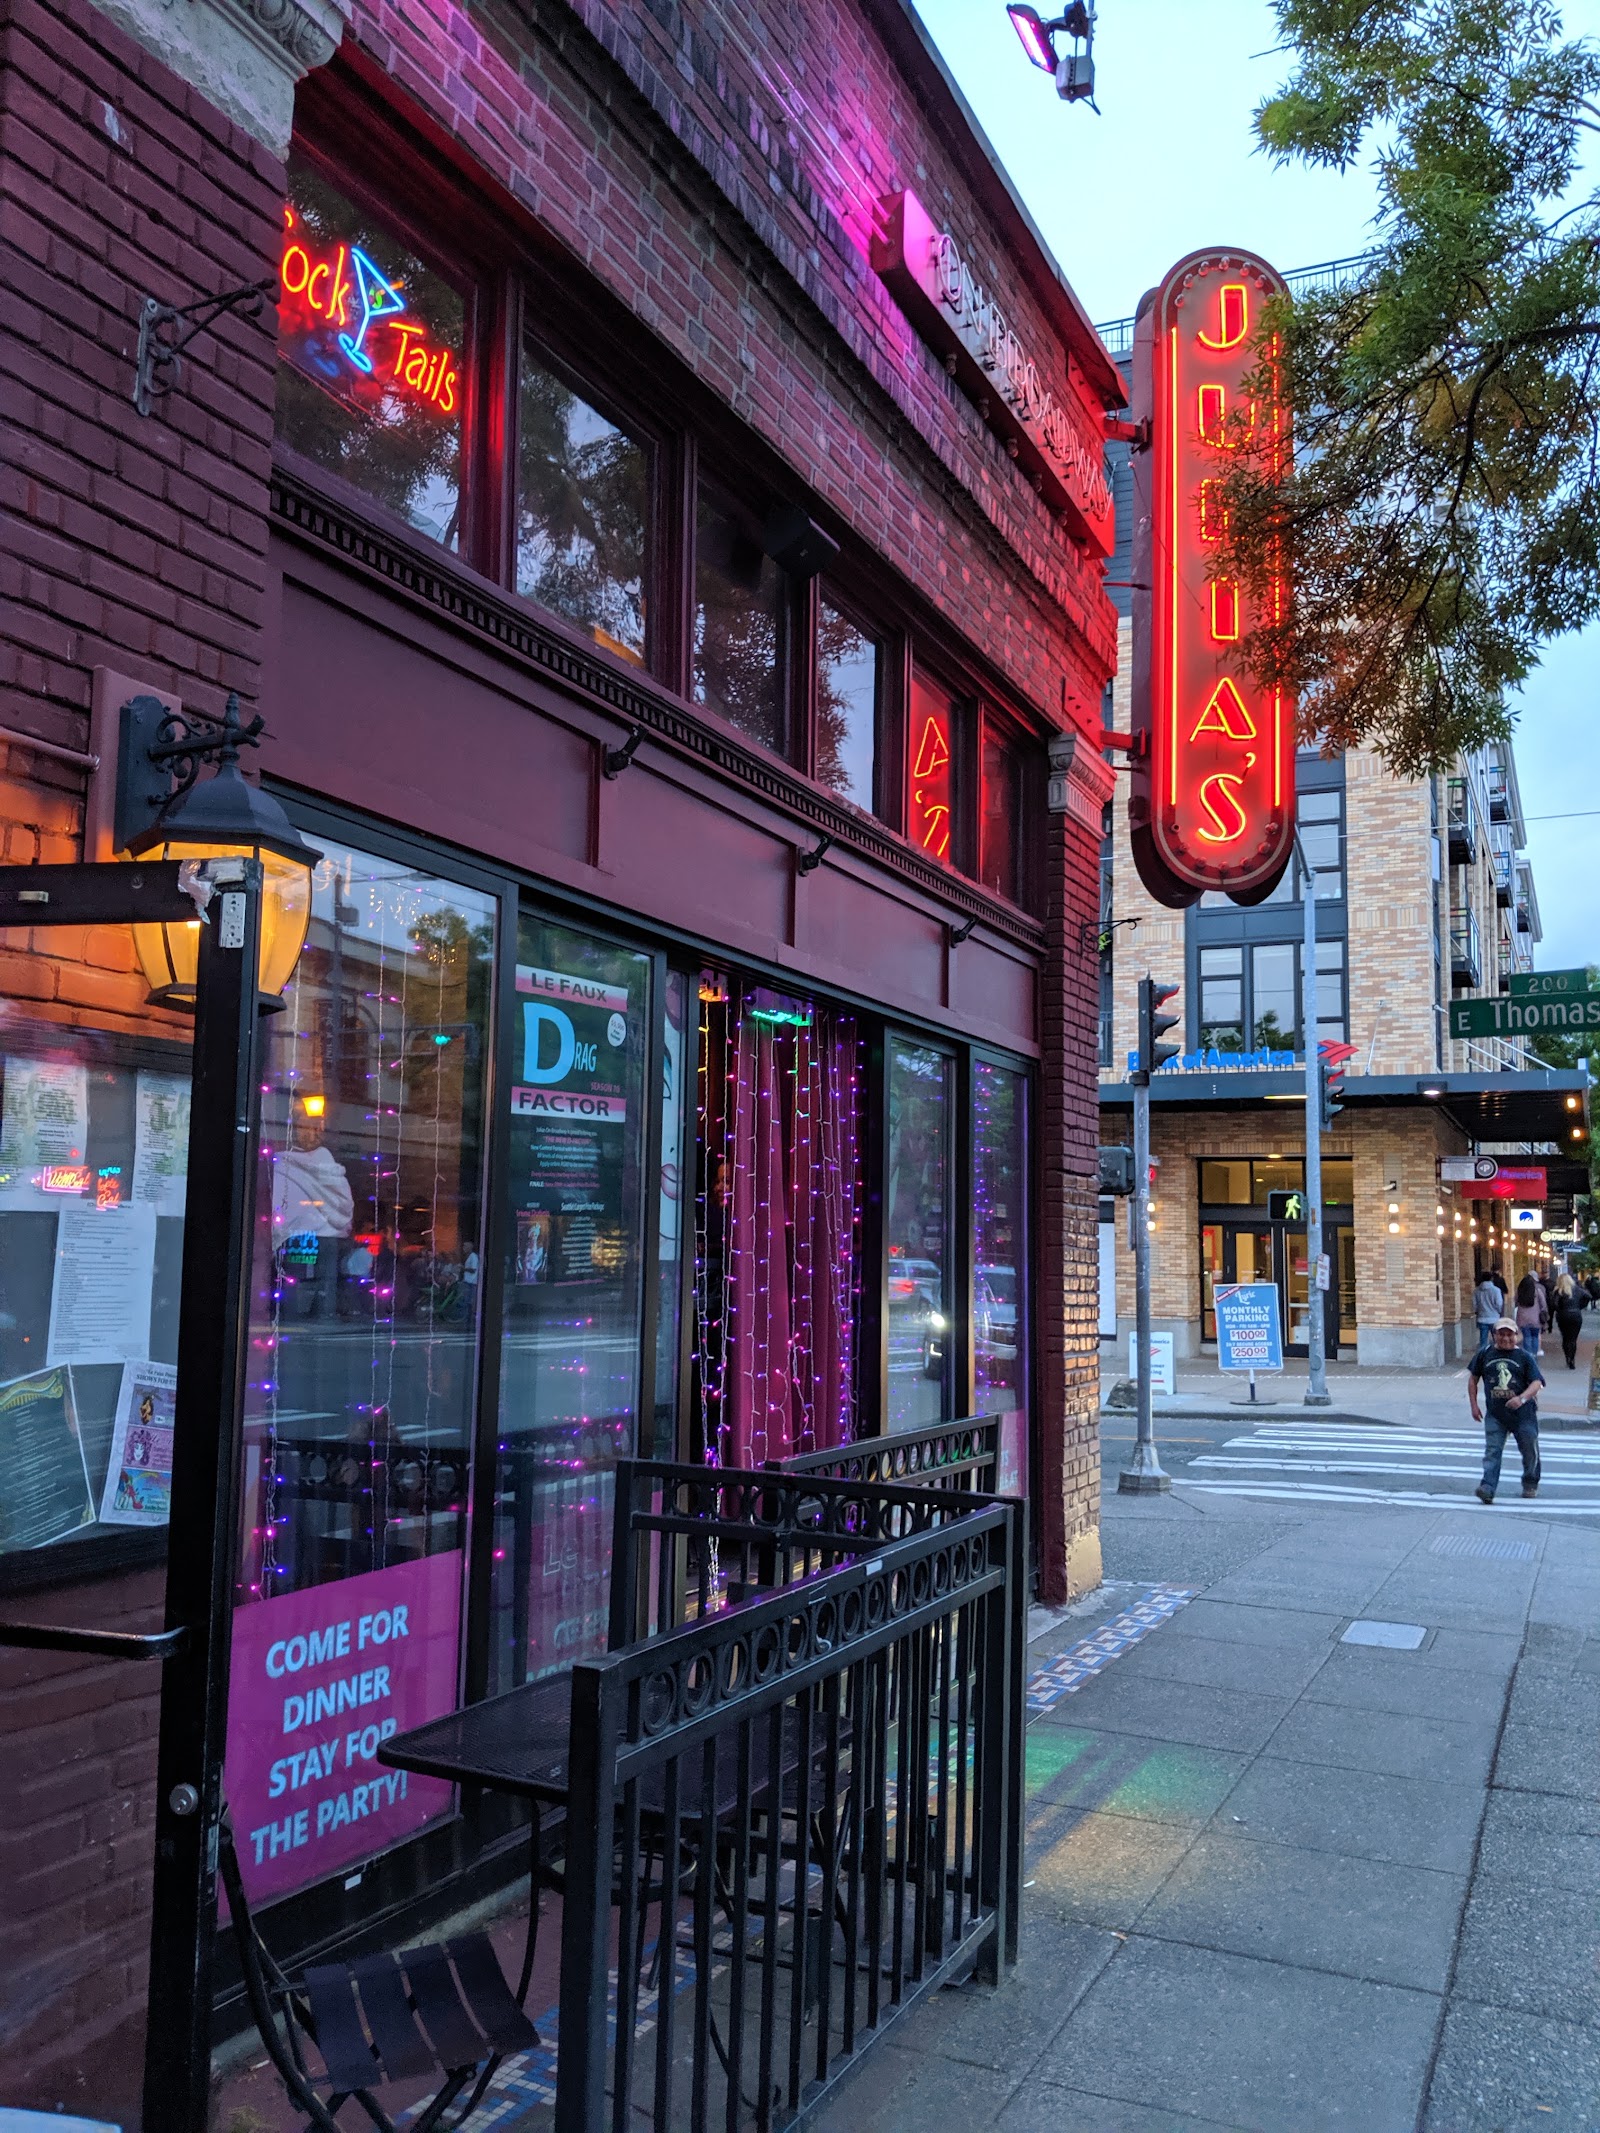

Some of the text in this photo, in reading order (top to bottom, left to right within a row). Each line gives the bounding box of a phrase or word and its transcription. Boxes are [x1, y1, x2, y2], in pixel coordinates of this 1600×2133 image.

[282, 230, 351, 326] ock
[388, 321, 456, 412] Tails
[985, 301, 1117, 524] BROADWAY
[531, 972, 608, 1002] LE FAUX
[1528, 976, 1568, 993] 200
[522, 1001, 598, 1085] DRAG
[1457, 1000, 1600, 1031] E Thomas
[1182, 1048, 1204, 1069] of
[1206, 1046, 1295, 1069] America
[518, 1092, 610, 1117] FACTOR
[1222, 1305, 1270, 1315] MONTHLY
[1225, 1313, 1270, 1323] PARKING
[264, 1604, 409, 1679] COME FOR
[282, 1665, 391, 1734] DINNER
[268, 1738, 339, 1799] STAY
[250, 1768, 408, 1866] THE PARTY!
